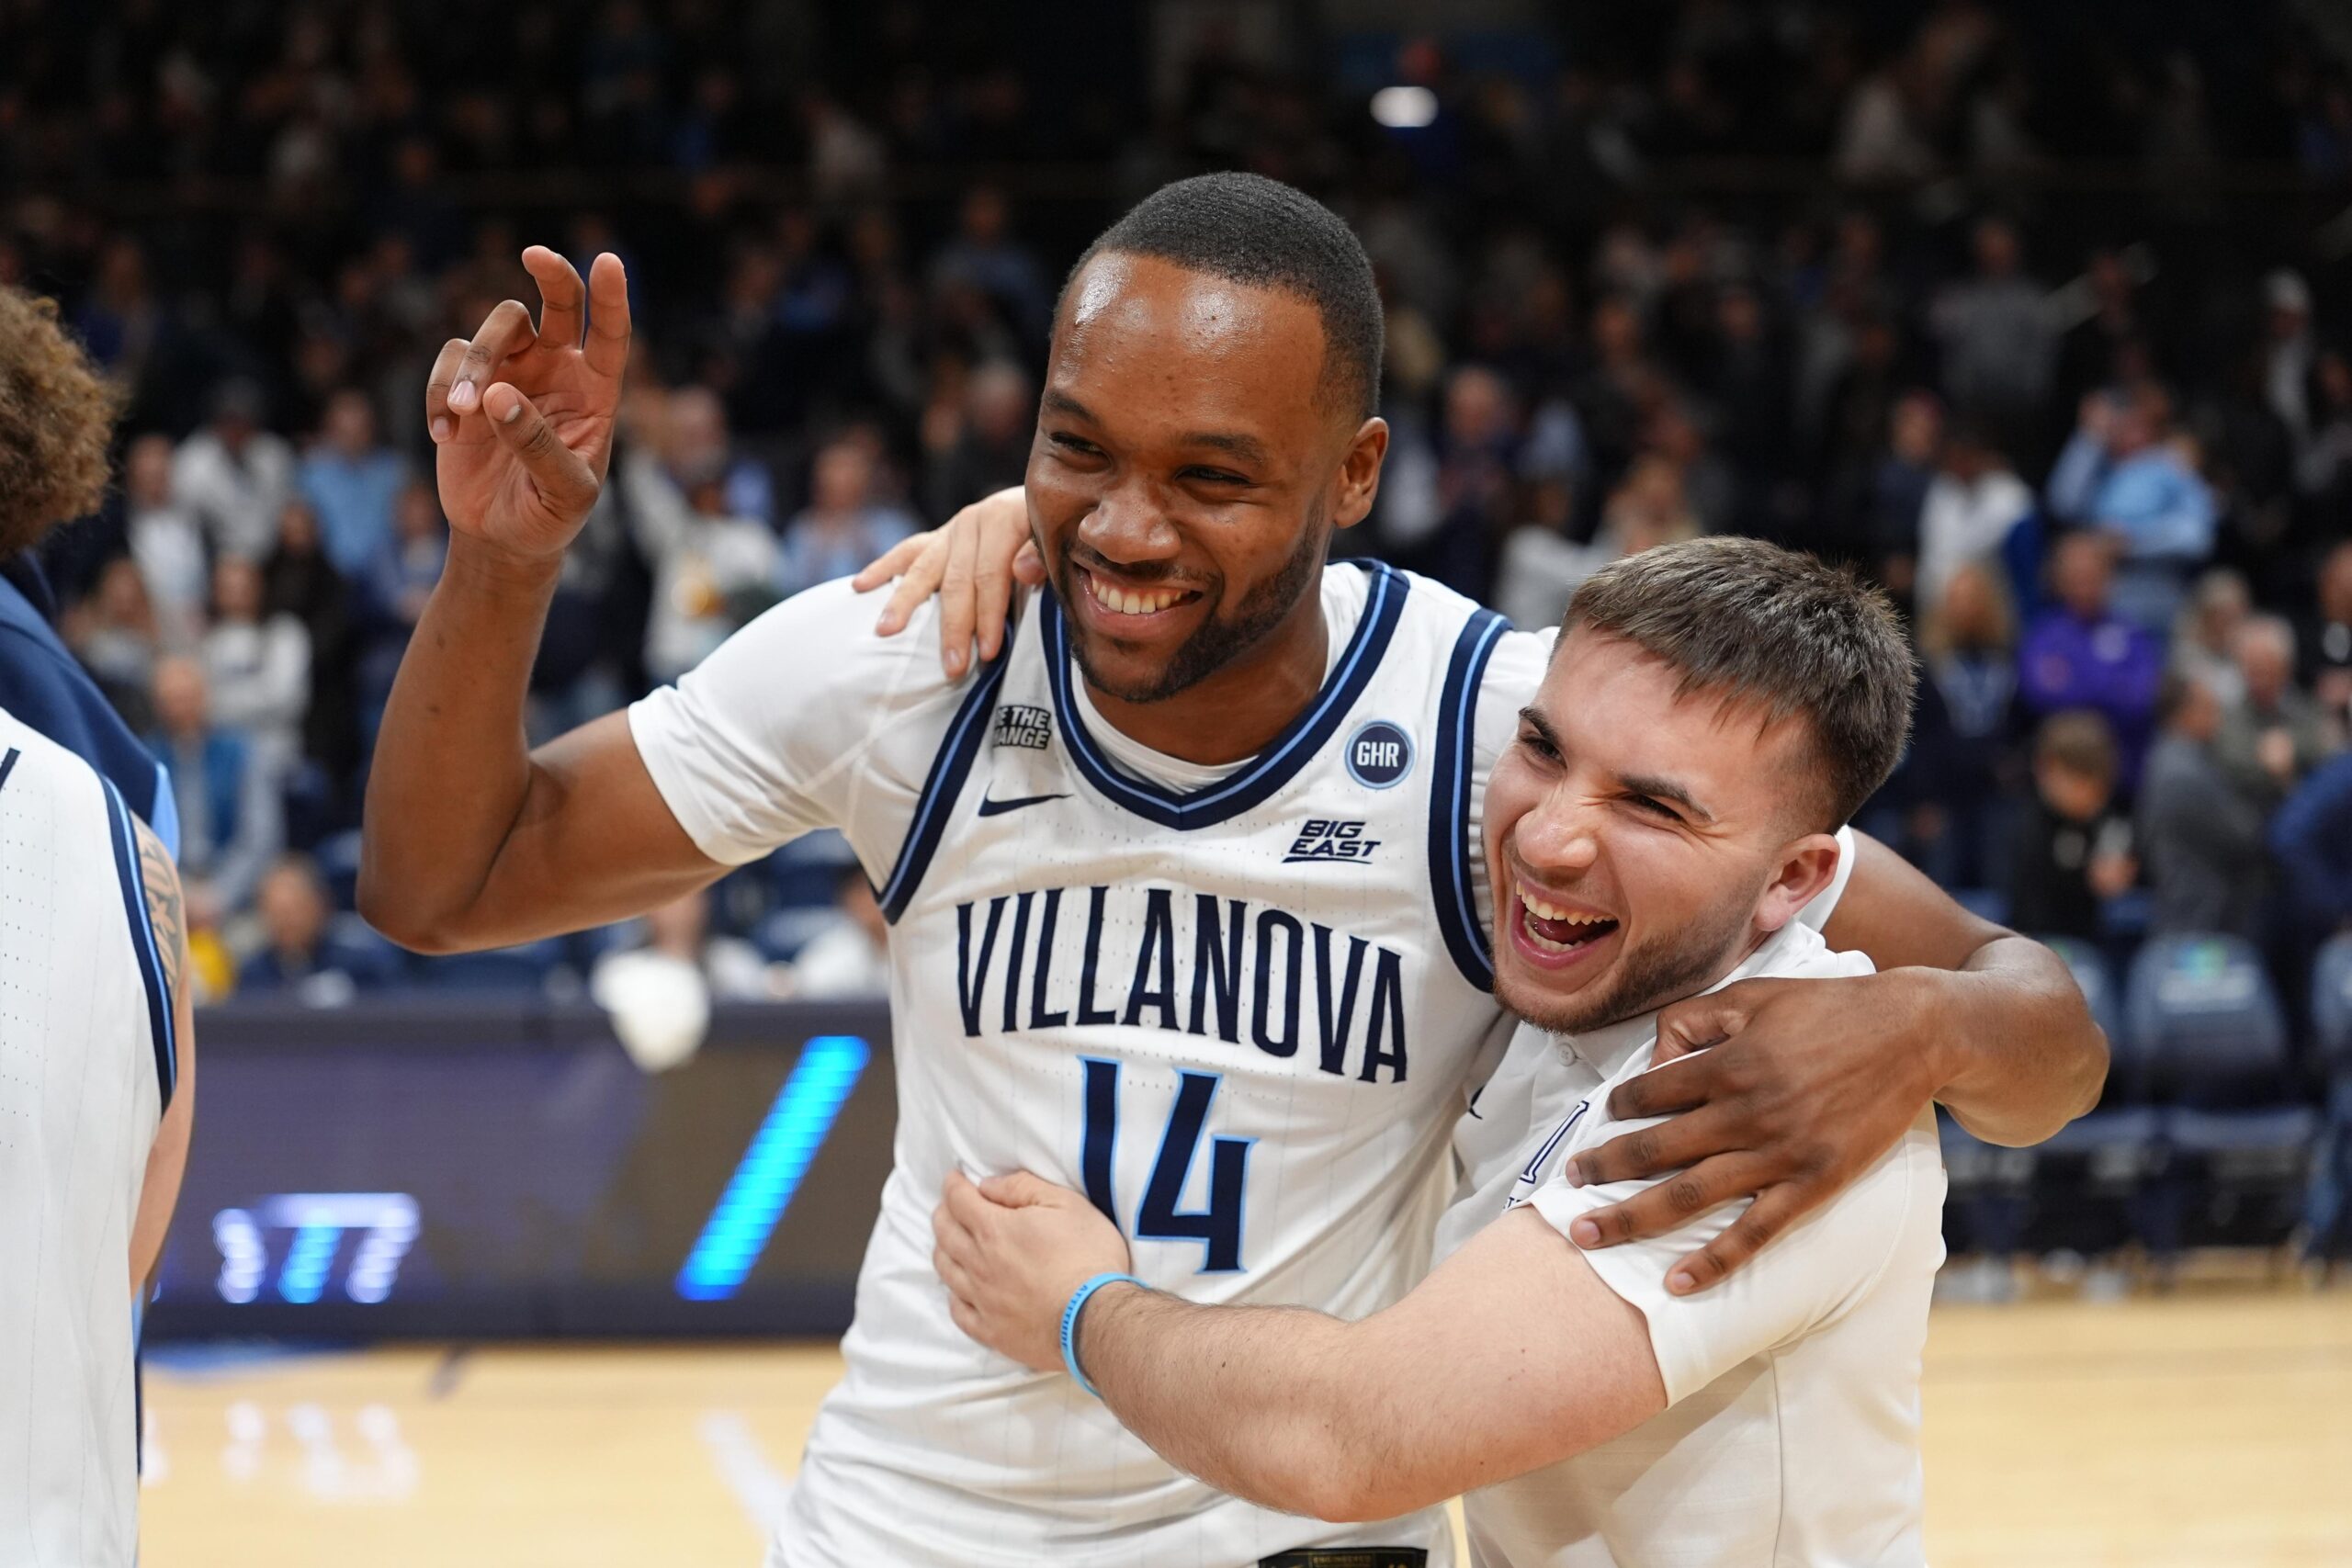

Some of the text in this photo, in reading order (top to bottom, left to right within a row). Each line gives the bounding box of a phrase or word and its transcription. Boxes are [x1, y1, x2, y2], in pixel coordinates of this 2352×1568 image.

[1011, 705, 1049, 728] THE
[994, 727, 1049, 749] ANGE
[1356, 740, 1400, 768] GHR
[1299, 819, 1366, 839] BIG
[1288, 838, 1382, 857] EAST
[956, 886, 1408, 1084] VILLANOVA
[1076, 1054, 1261, 1276] 14
